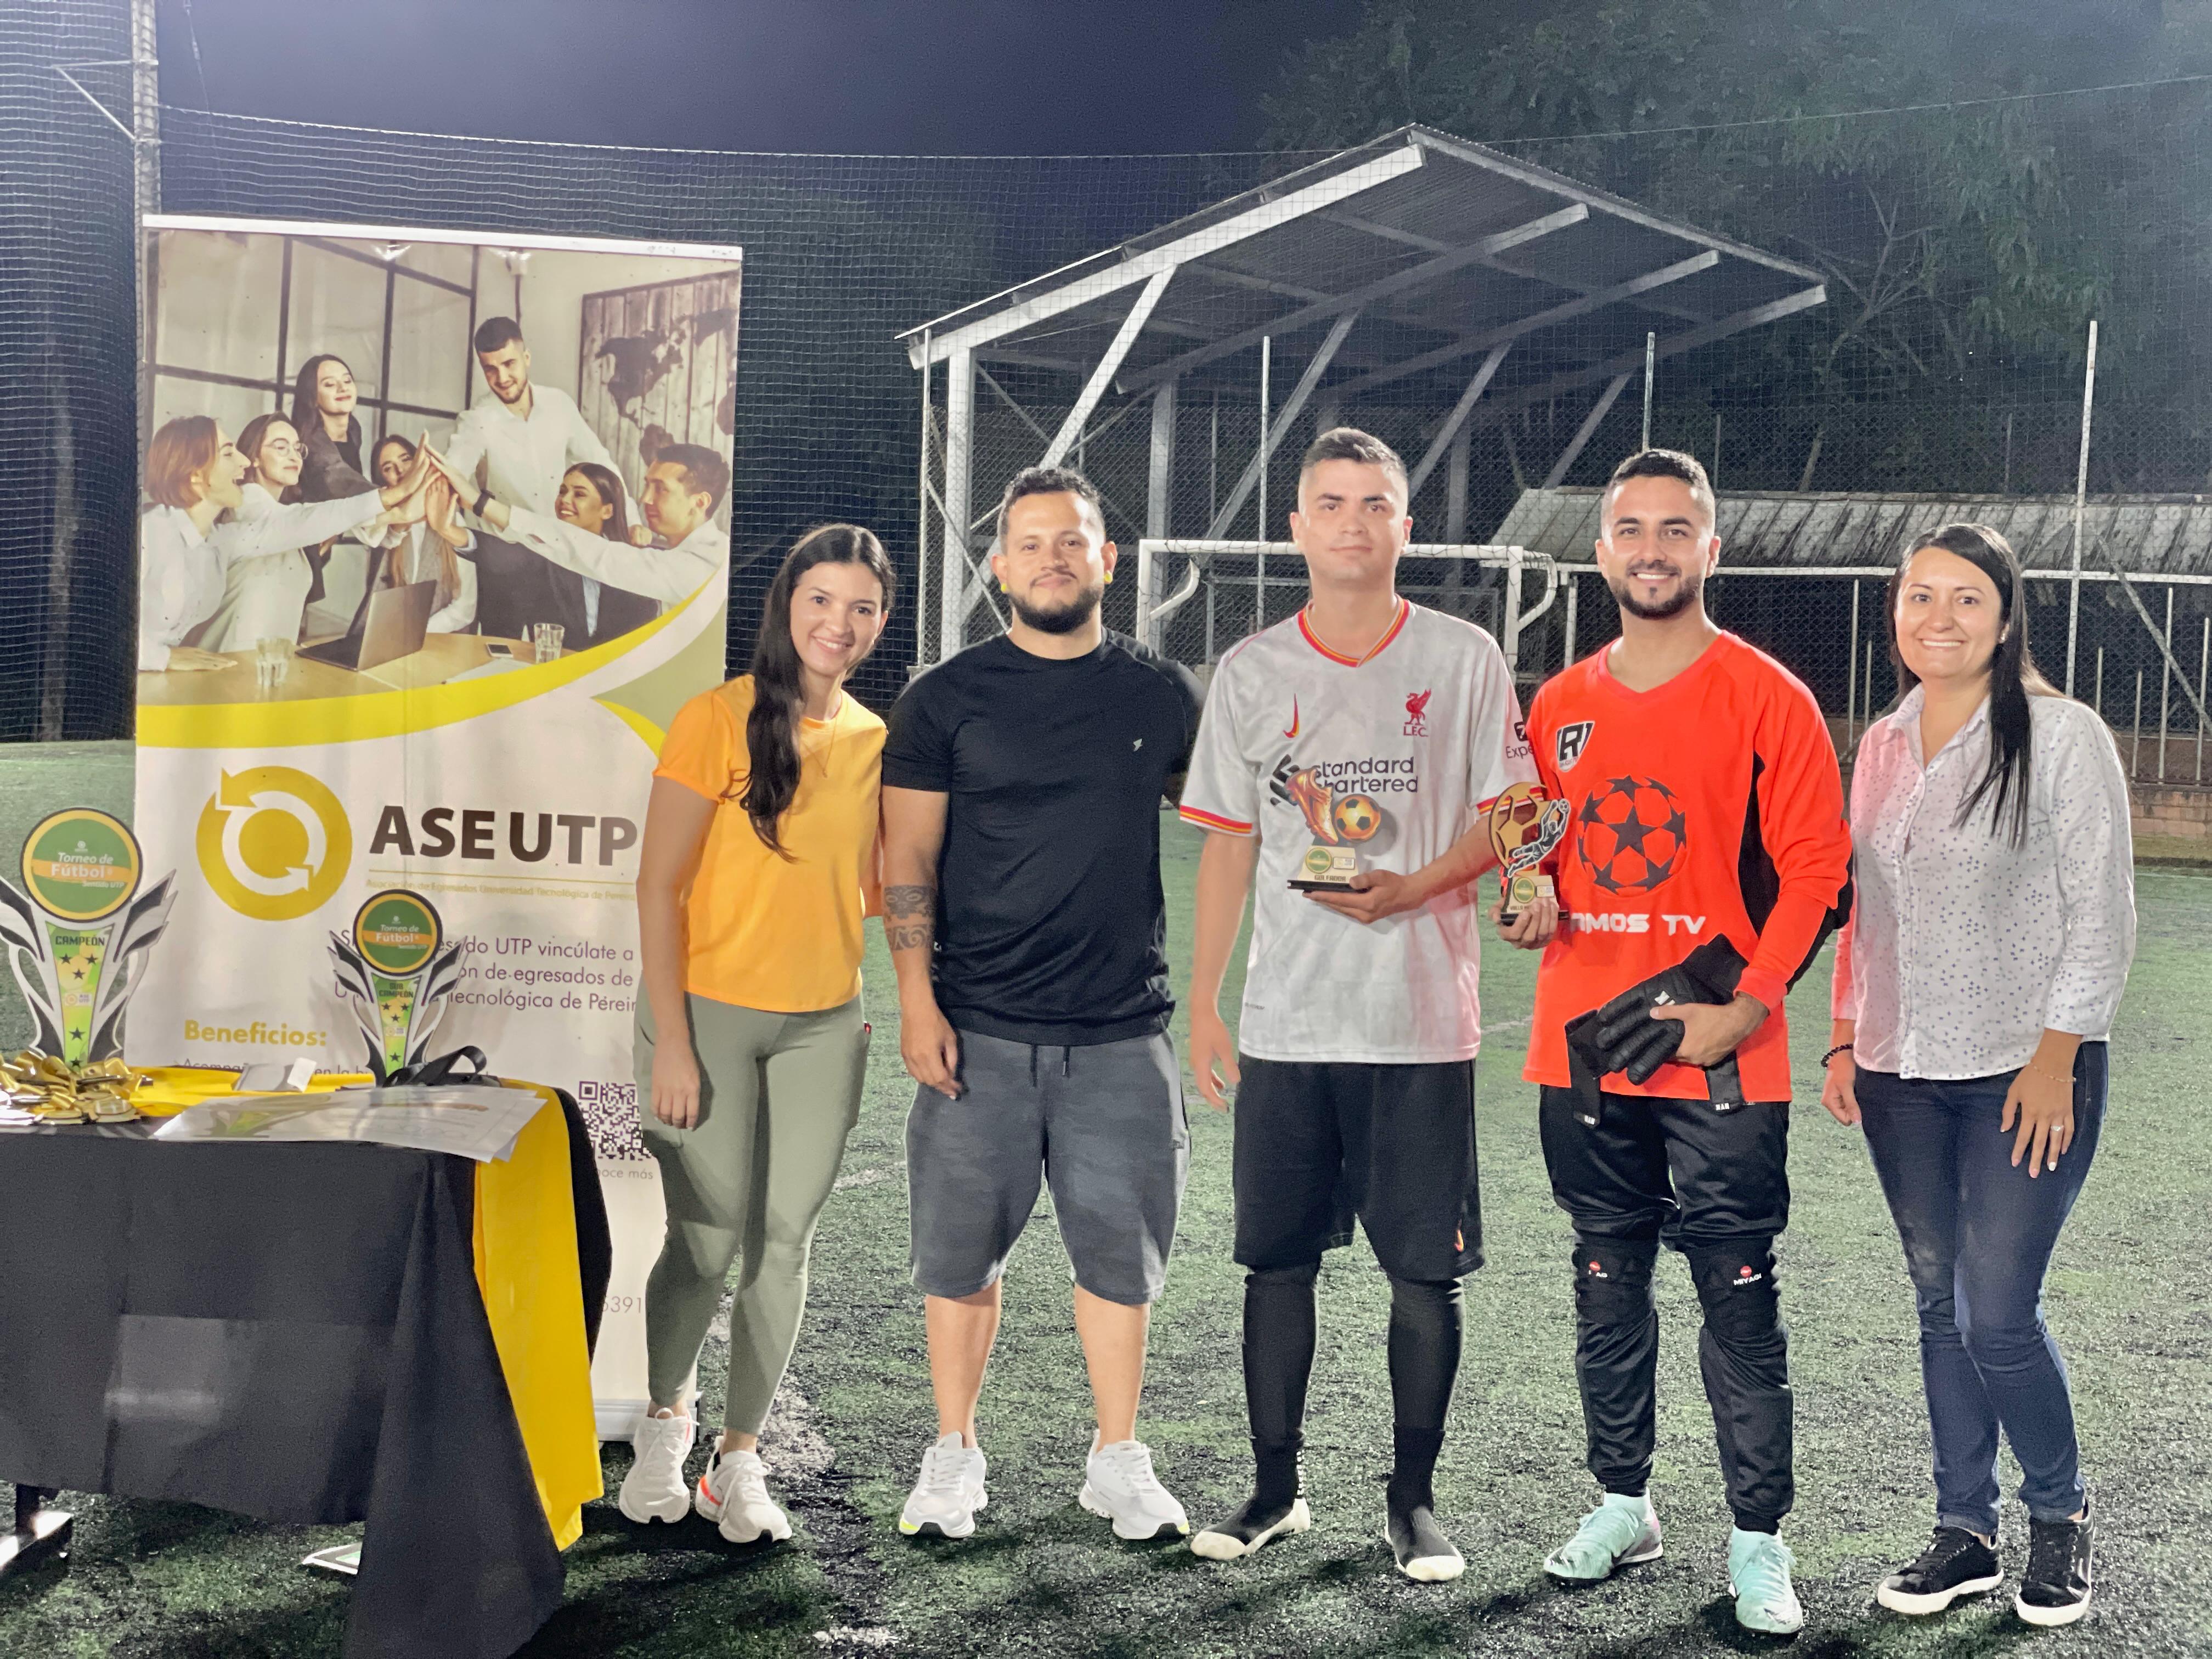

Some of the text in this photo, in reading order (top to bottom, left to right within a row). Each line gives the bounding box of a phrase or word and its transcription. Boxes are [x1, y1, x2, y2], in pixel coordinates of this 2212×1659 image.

[1311, 756, 1414, 779] standard
[369, 805, 637, 866] ASE UTP
[58, 852, 114, 865] Torneo de
[51, 863, 105, 878] Fútbol
[381, 924, 408, 933] Torneo
[1570, 912, 1706, 936] AMOS TV
[55, 934, 105, 946] CAMPEÓN
[496, 938, 532, 955] UTP
[538, 941, 617, 961] vincúlate
[623, 949, 634, 961] a
[485, 962, 507, 980] de
[514, 966, 605, 986] egresados
[612, 968, 633, 986] de
[560, 991, 582, 1009] de
[589, 993, 636, 1012] Pereir
[184, 1019, 327, 1047] Beneficios:
[598, 1168, 653, 1180] oce más
